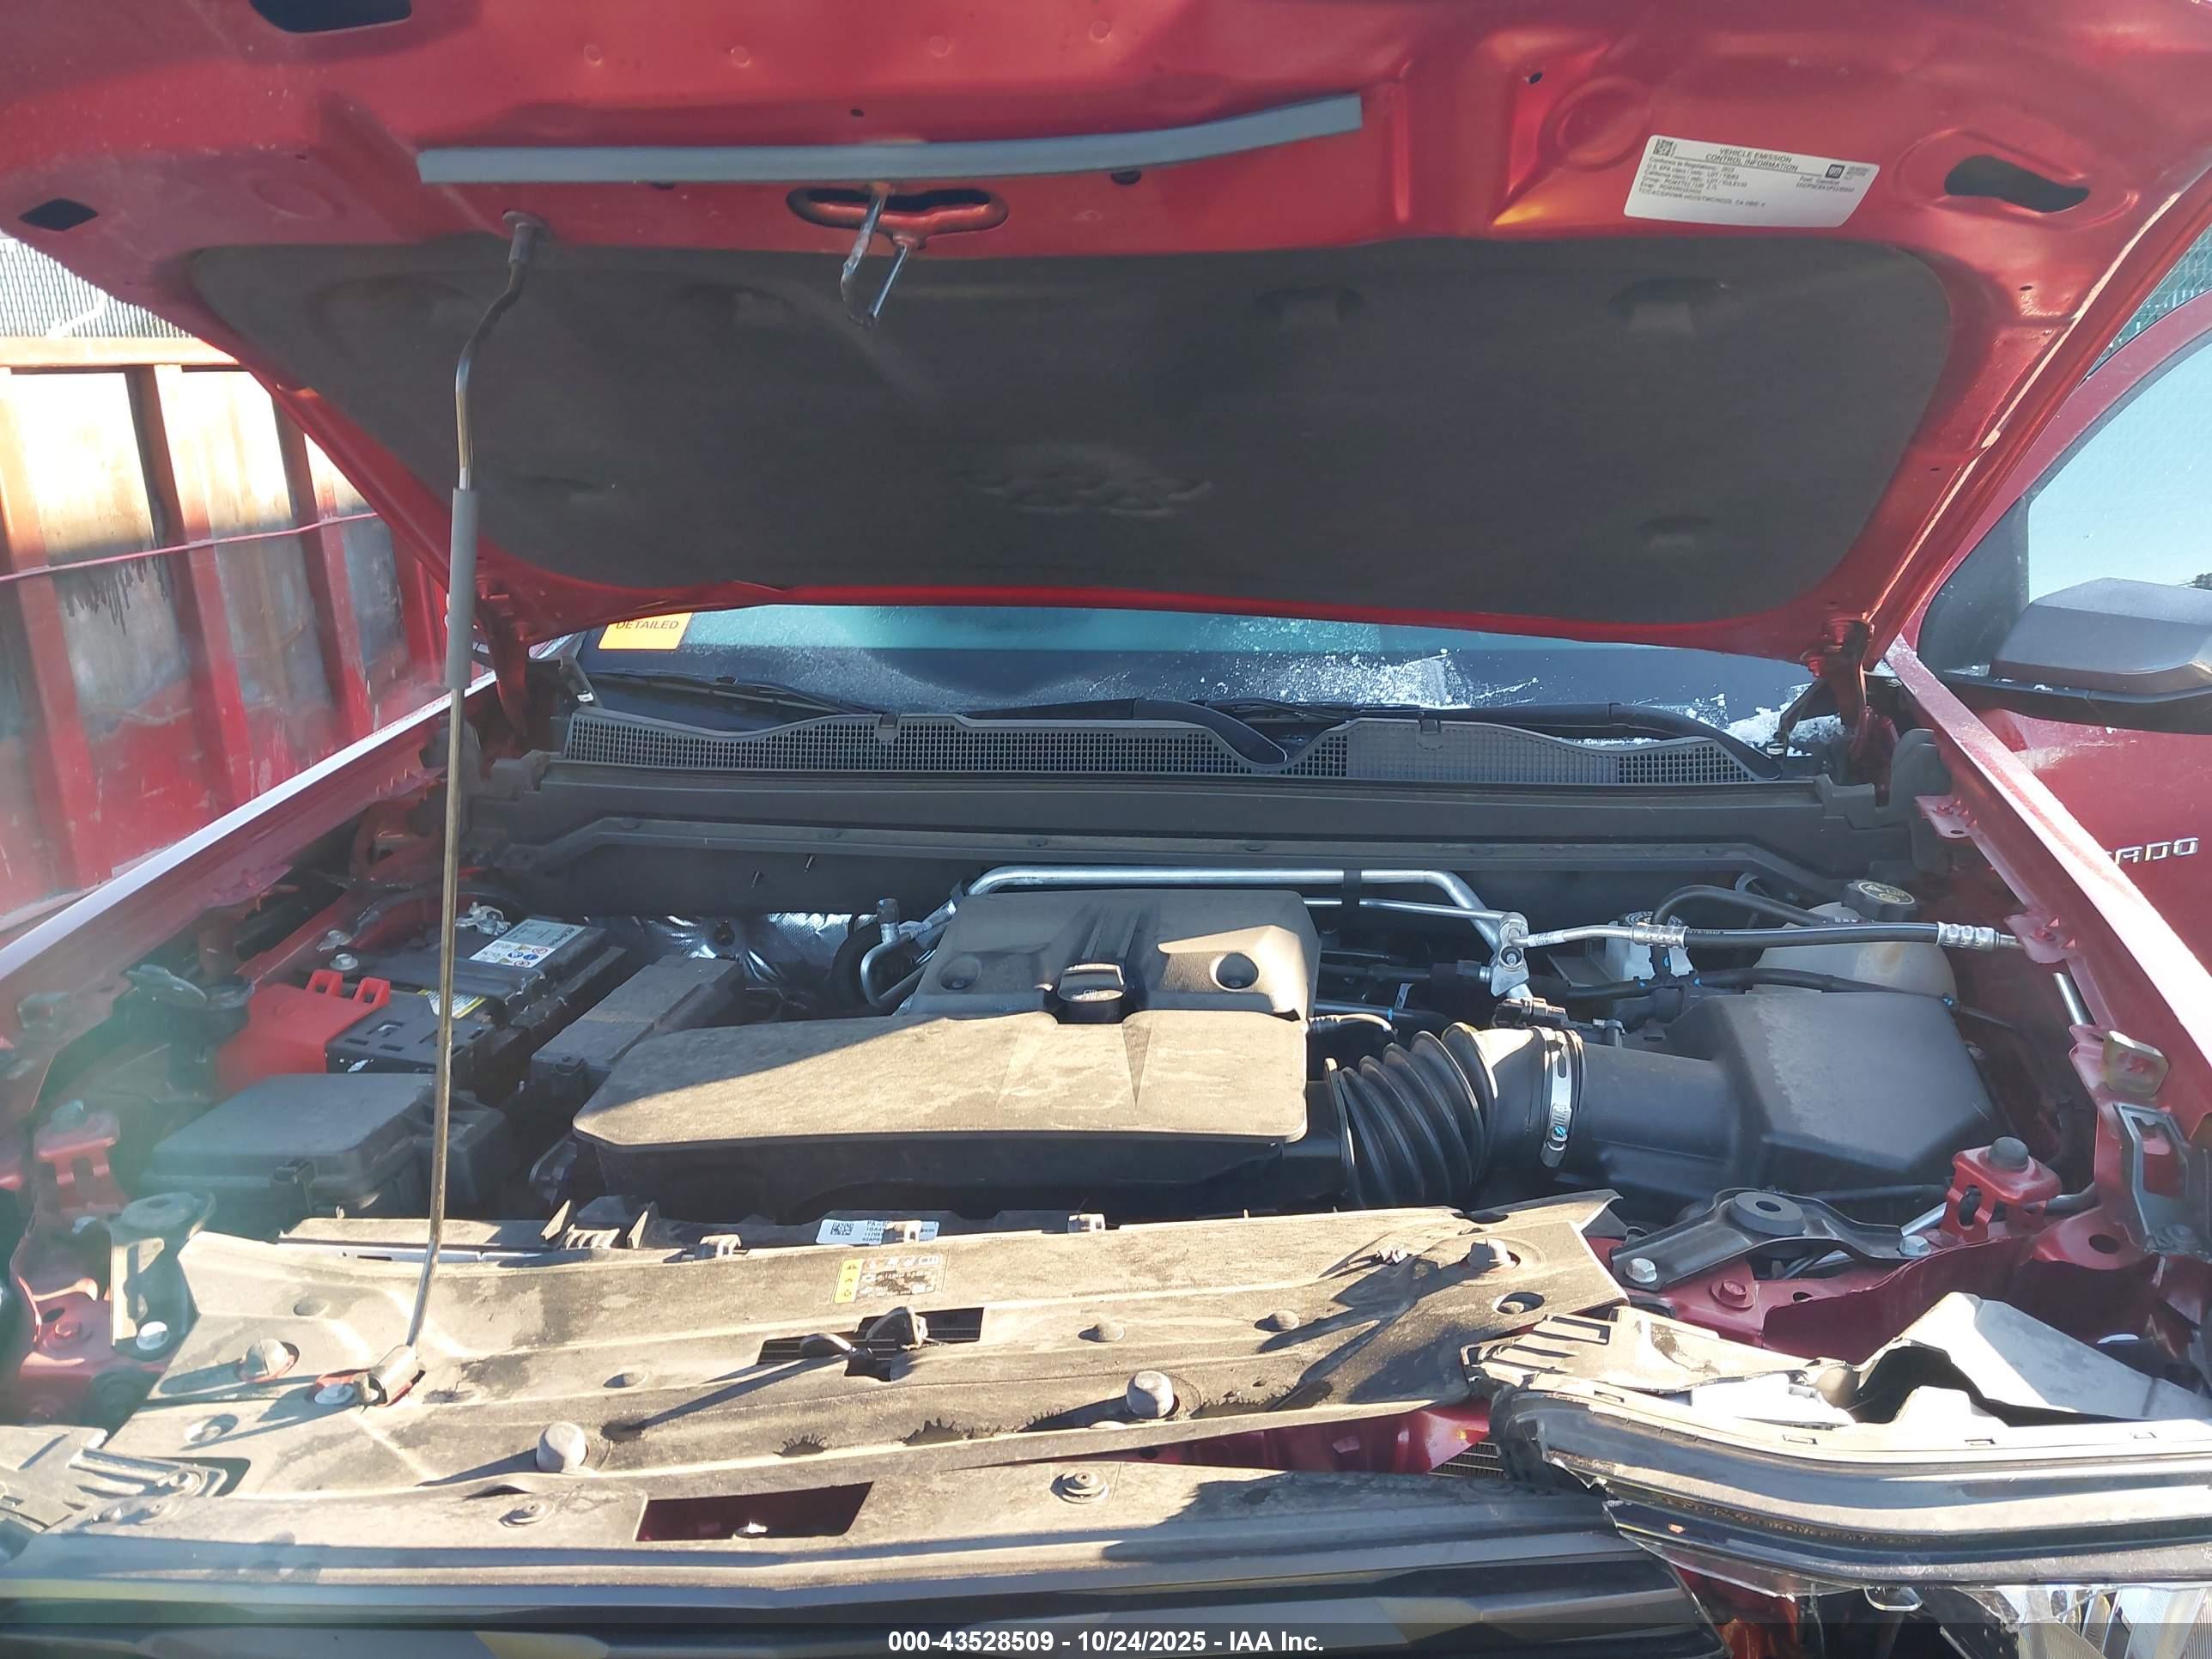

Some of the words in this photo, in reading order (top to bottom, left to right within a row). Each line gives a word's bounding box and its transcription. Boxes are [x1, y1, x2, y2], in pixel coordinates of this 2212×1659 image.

[1720, 148, 1752, 158] VEHICLE
[1754, 151, 1792, 163] EMISSION
[1705, 154, 1742, 164] CONTROL
[1743, 158, 1799, 173] INFORMATION
[616, 620, 678, 629] DETAILED
